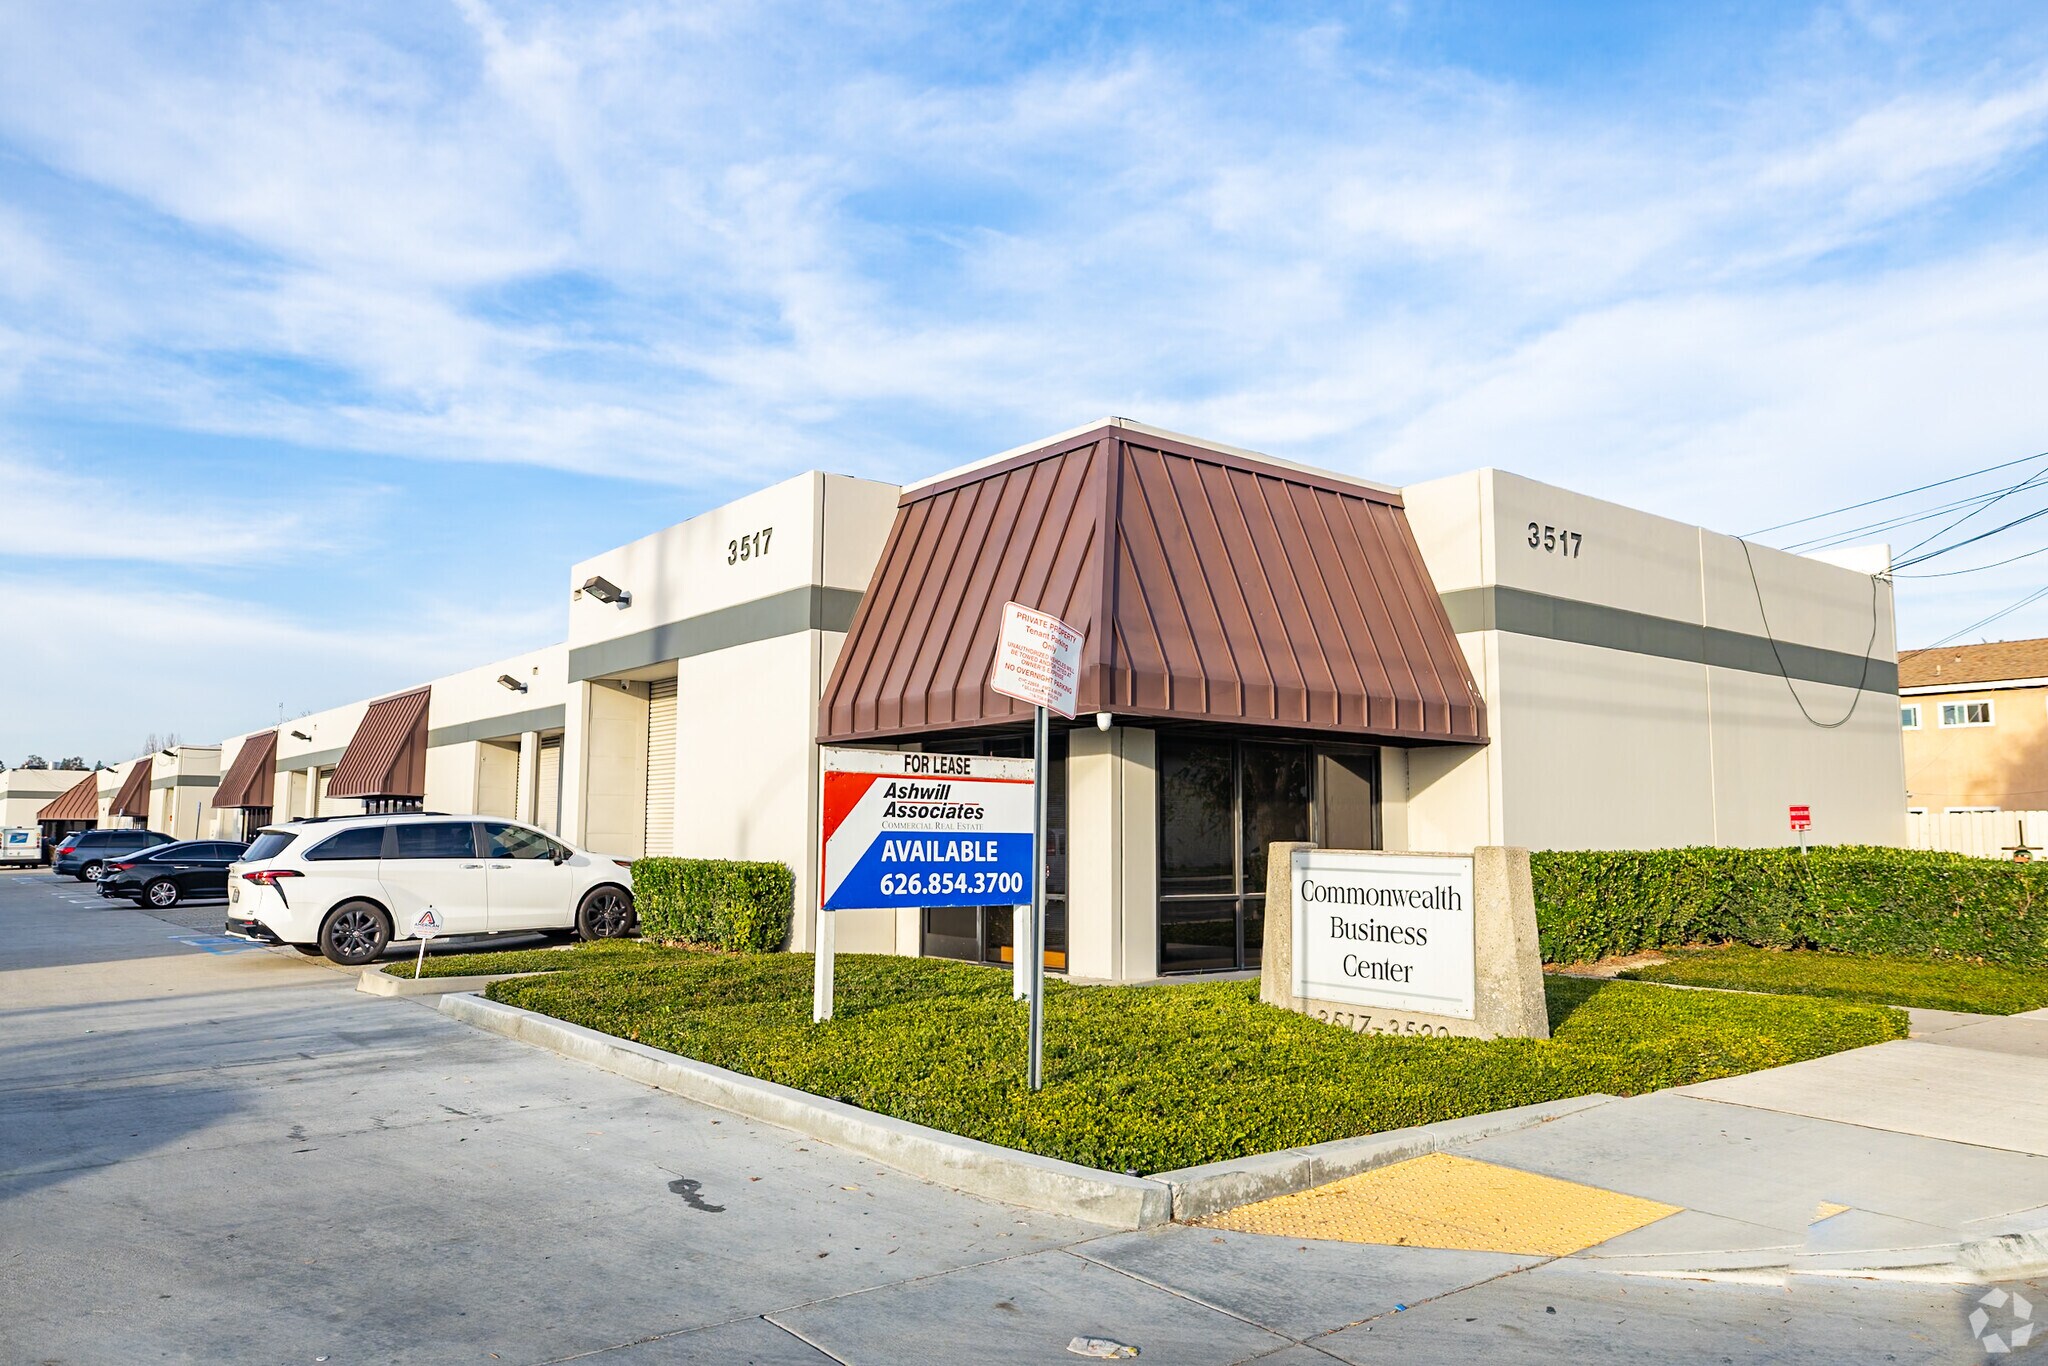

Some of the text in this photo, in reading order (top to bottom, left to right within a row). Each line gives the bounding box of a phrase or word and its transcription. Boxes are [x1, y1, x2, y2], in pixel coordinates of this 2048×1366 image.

[728, 526, 773, 566] 3517
[1527, 521, 1582, 559] 3517
[1016, 611, 1076, 643] PRIVATE PROPERTY
[1026, 625, 1068, 651] Tenant Parking
[1007, 642, 1048, 658] UNAUTHORIZED
[1019, 652, 1038, 662] TOWED
[1042, 641, 1057, 654] Only
[1021, 659, 1045, 670] OWNER'S
[1004, 663, 1015, 671] NO
[1016, 667, 1053, 683] OVERNIGHT
[1054, 680, 1071, 694] PARKING
[904, 754, 971, 775] FOR LEASE
[883, 782, 951, 801] Ashwill
[883, 801, 984, 820] Associates
[881, 821, 984, 831] COMMERCIAL REAL ESTATE
[881, 839, 998, 862] AVAILABLE
[880, 872, 1023, 895] 626.854.3700
[1301, 879, 1463, 911] Commonwealth
[1330, 916, 1428, 946] Business
[1343, 954, 1413, 983] Center
